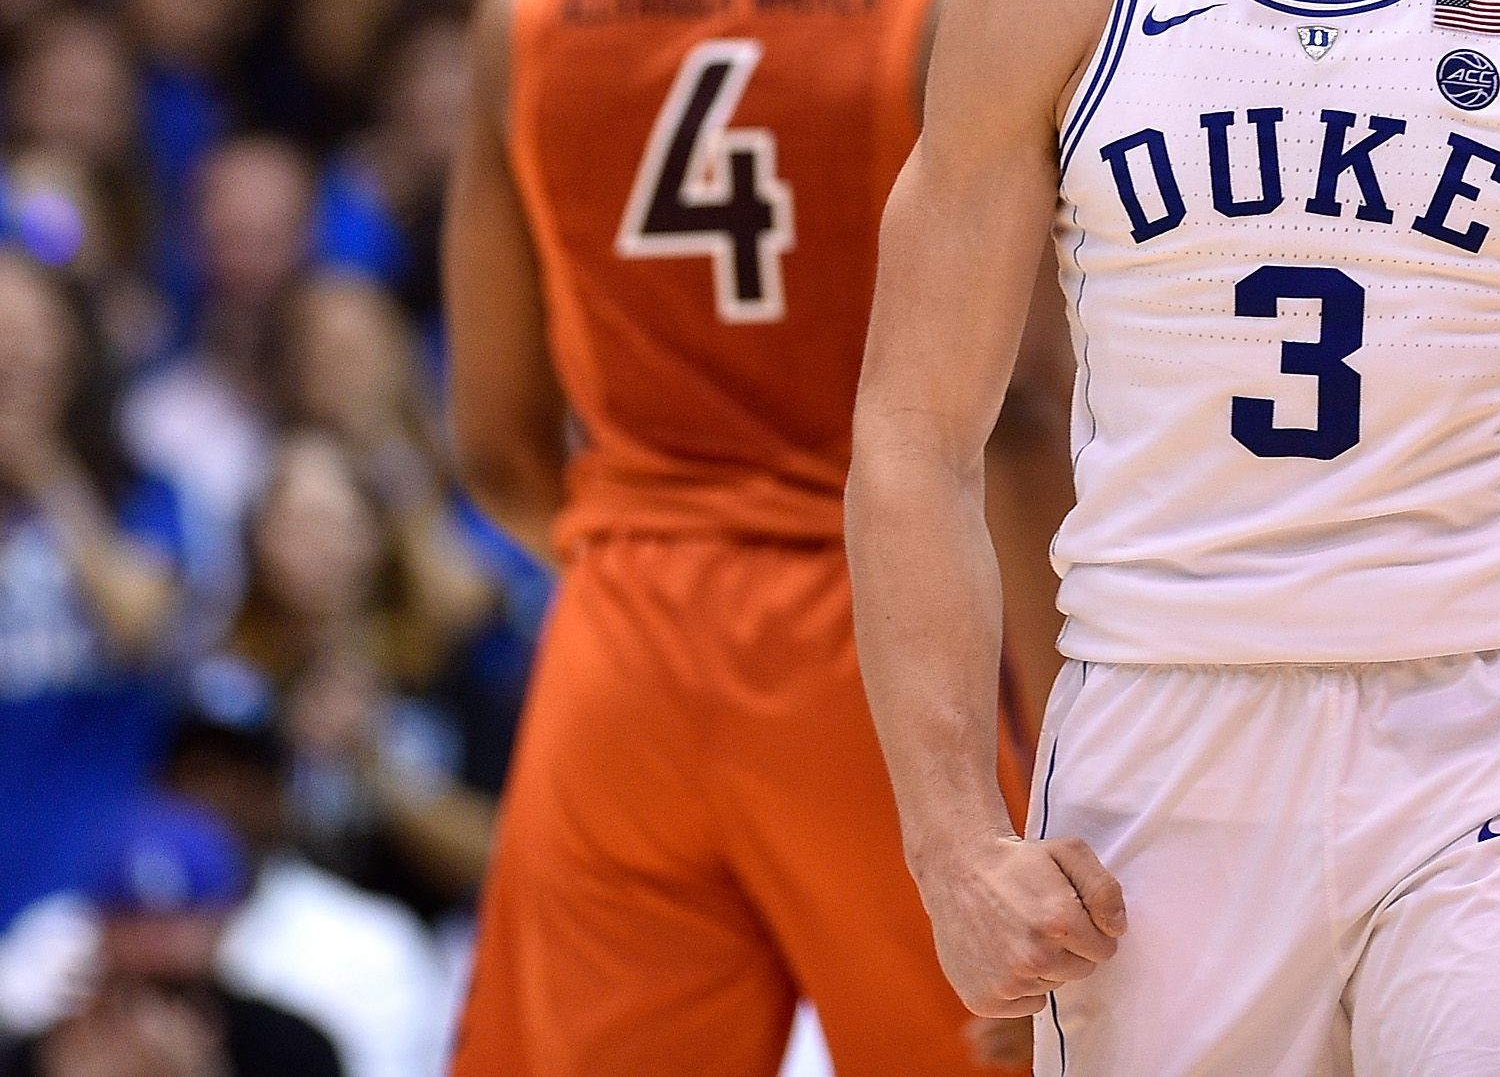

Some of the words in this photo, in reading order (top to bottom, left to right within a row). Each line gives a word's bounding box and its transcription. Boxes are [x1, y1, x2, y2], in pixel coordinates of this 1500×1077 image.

[1447, 68, 1496, 86] ACC
[614, 37, 797, 324] 4
[1231, 265, 1365, 460] 3
